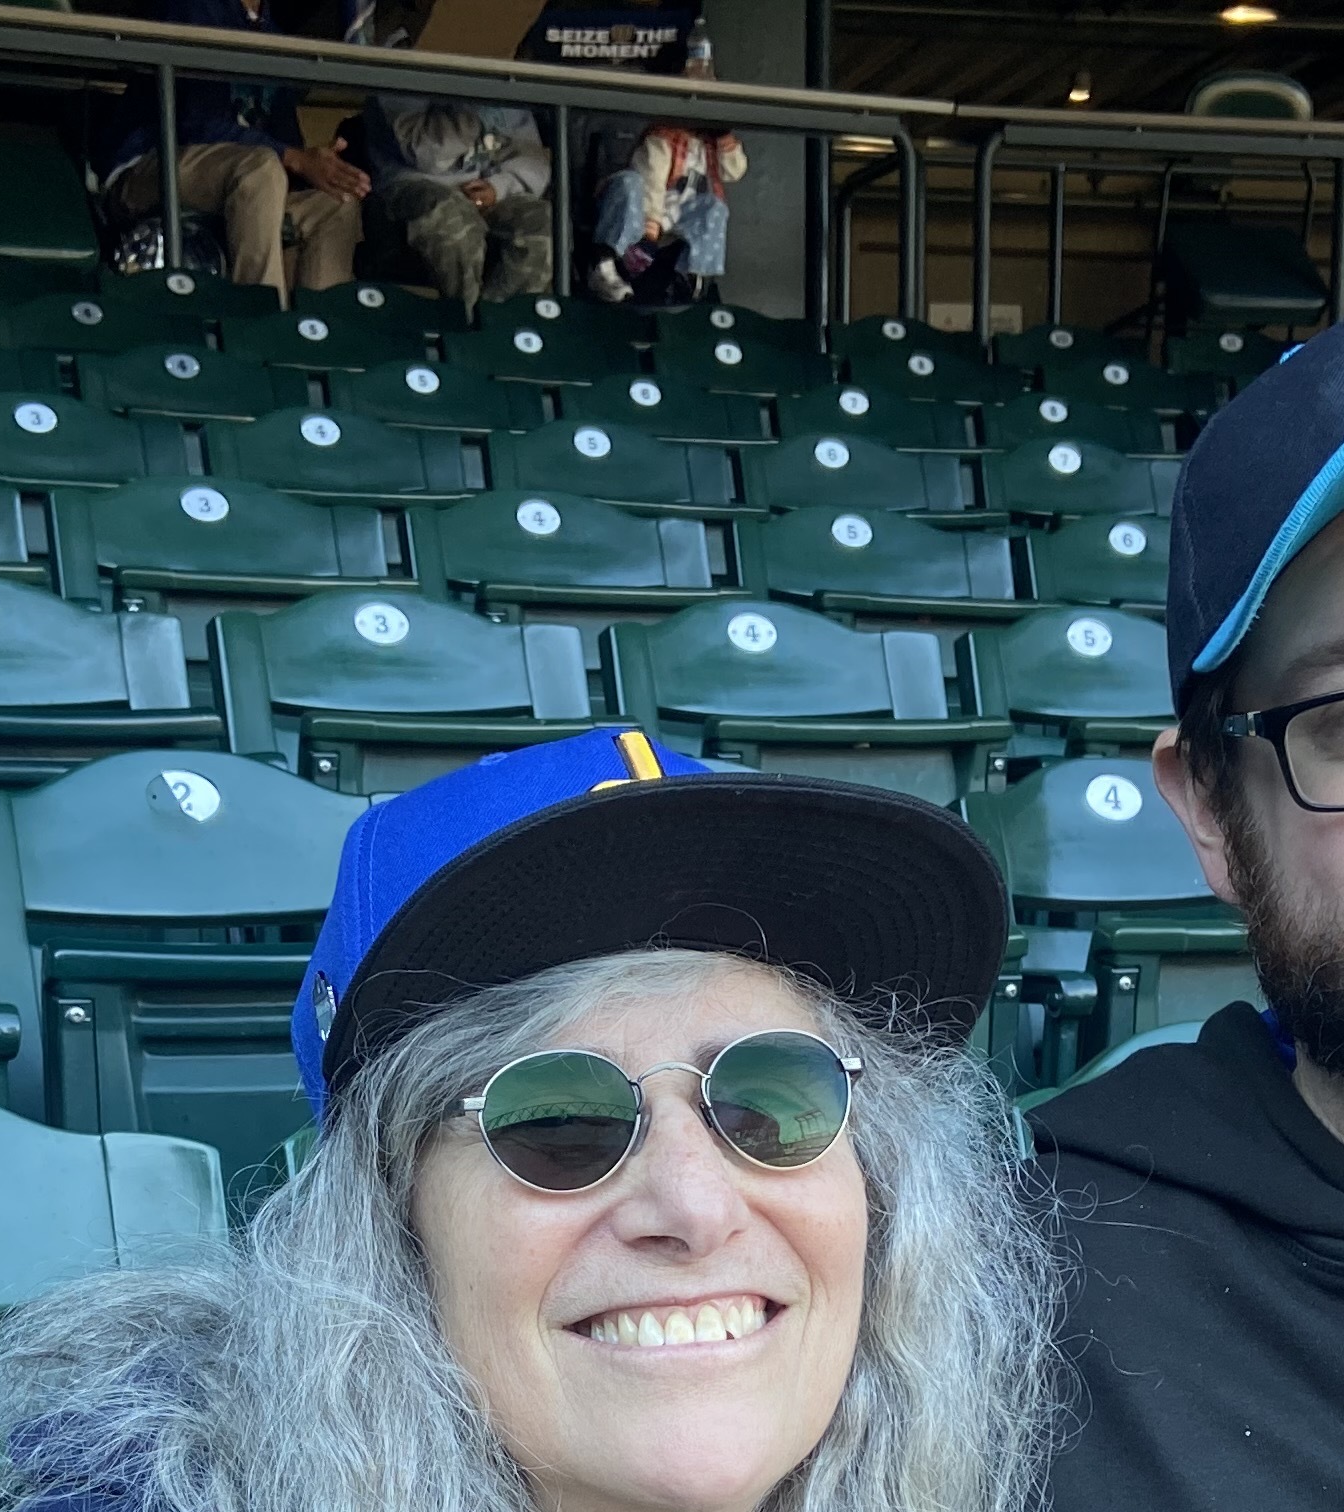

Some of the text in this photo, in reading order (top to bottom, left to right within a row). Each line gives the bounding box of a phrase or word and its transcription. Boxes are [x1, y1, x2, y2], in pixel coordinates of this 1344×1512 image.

[546, 28, 677, 43] SEIZE THE
[561, 44, 661, 58] MOMENT
[31, 411, 41, 425] 3
[315, 425, 325, 439] 4
[587, 436, 597, 449] 5
[828, 448, 837, 461] 6
[199, 497, 211, 512] 3
[532, 510, 545, 526] 4
[847, 525, 857, 539] 5
[1123, 533, 1133, 547] 6
[374, 614, 389, 633] 3
[744, 624, 760, 642] 4
[1084, 630, 1096, 647] 5
[172, 781, 193, 811] 2
[1104, 785, 1122, 810] 4
